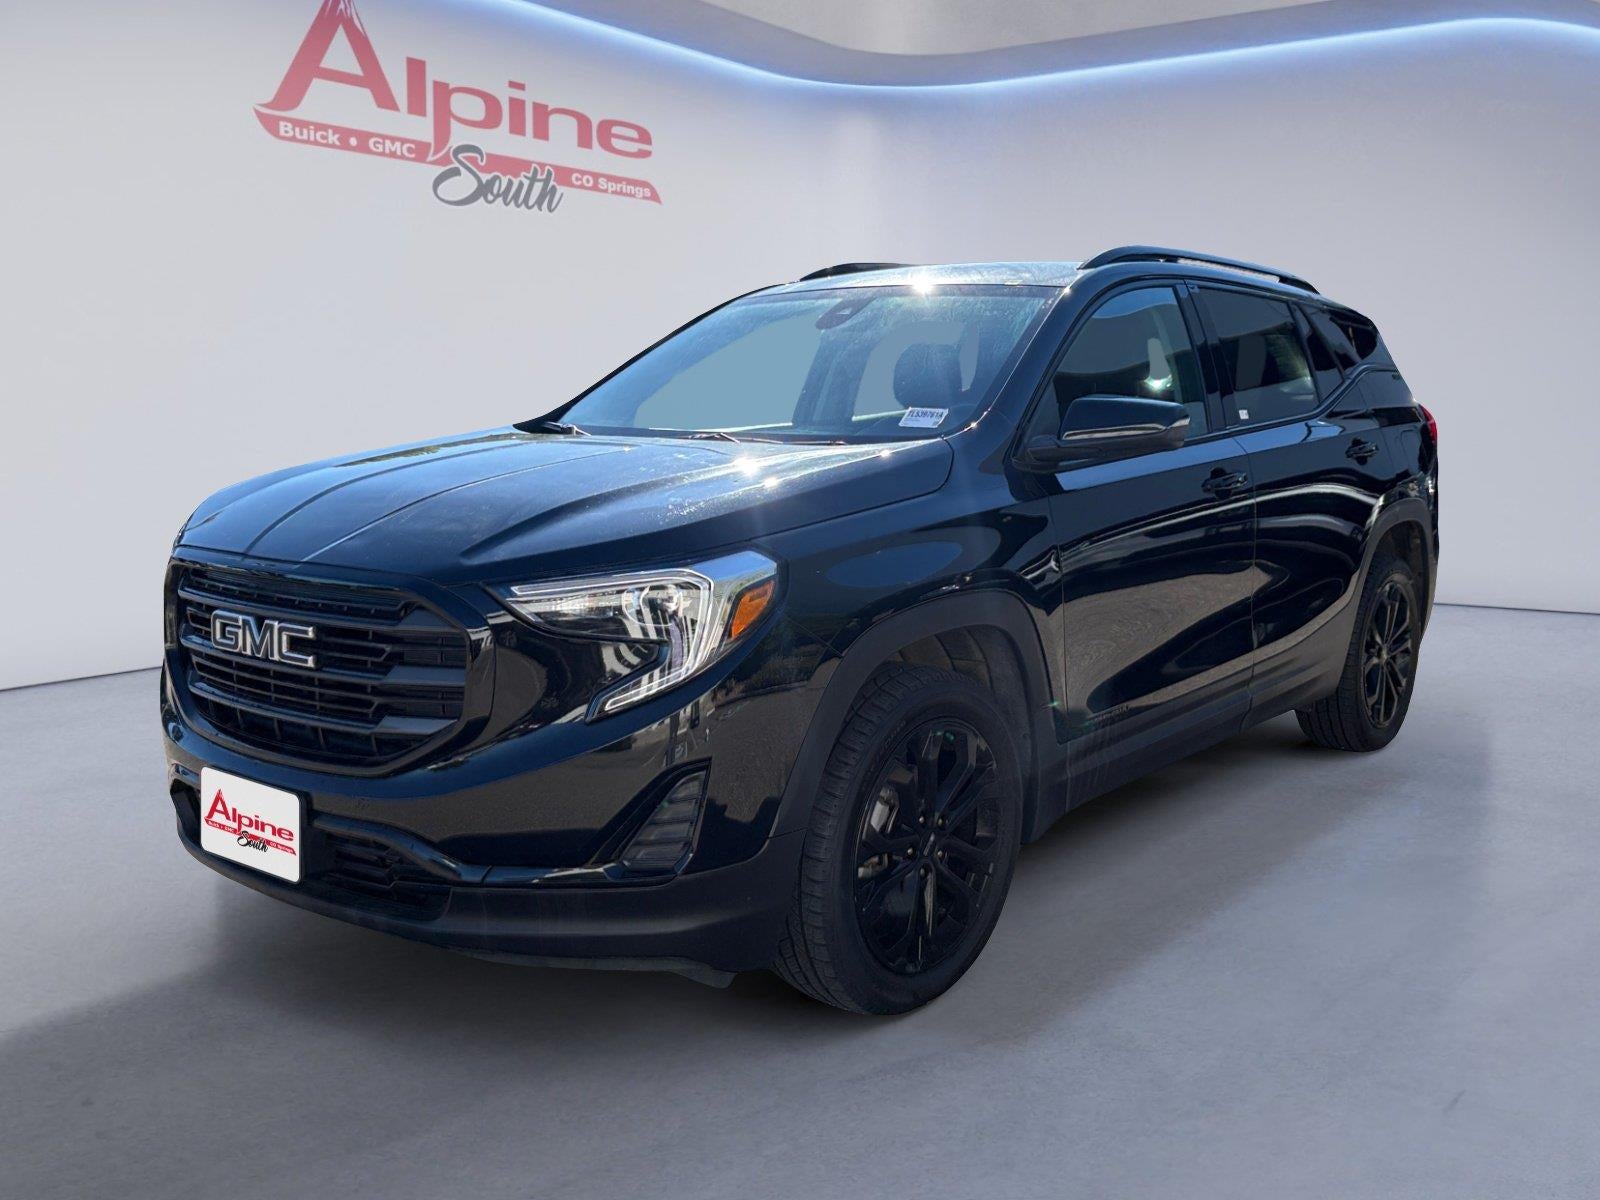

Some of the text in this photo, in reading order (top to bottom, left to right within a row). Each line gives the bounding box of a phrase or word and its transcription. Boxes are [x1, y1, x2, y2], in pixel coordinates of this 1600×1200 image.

[254, 0, 652, 160] Alpine
[278, 120, 416, 159] Buick GMC
[432, 143, 564, 214] South
[571, 172, 651, 200] CO Springs
[211, 609, 315, 669] GMC
[204, 788, 293, 841] Alpine
[237, 830, 268, 853] South
